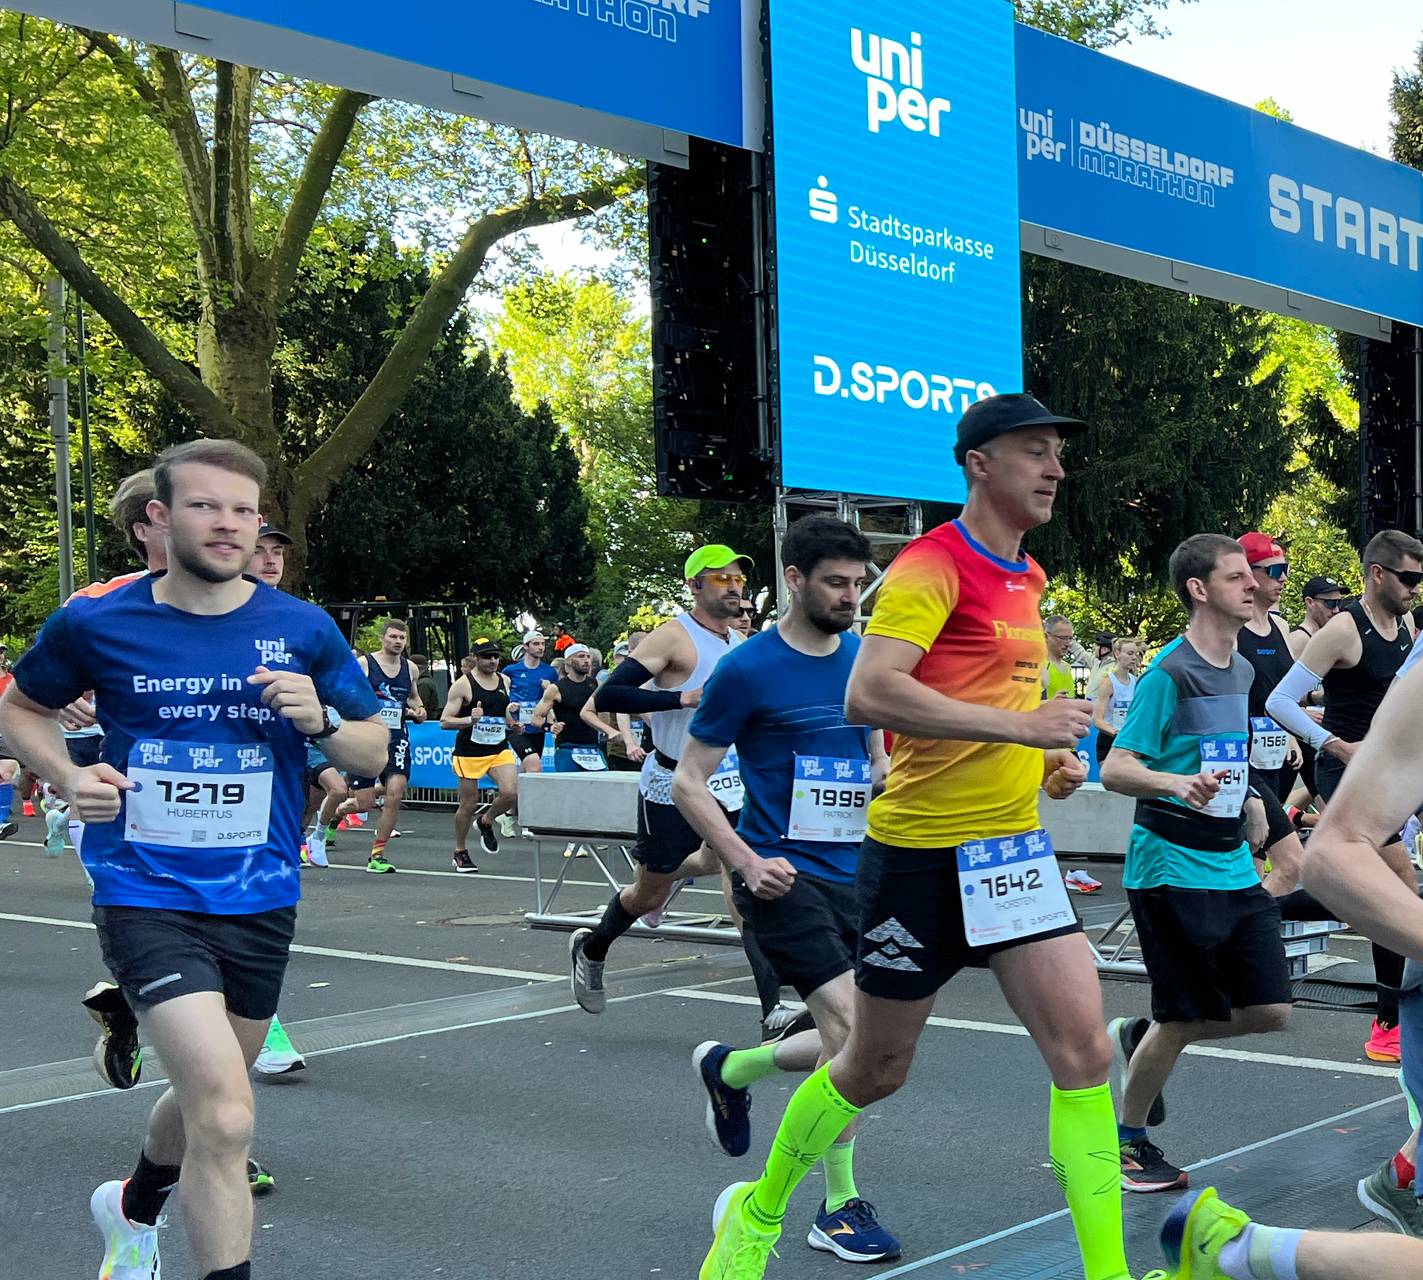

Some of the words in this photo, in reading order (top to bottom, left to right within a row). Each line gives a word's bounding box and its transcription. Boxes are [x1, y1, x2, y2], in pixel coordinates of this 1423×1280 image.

[850, 28, 922, 88] uni
[866, 74, 951, 138] per
[1019, 108, 1053, 138] uni
[1026, 132, 1066, 163] per
[1079, 121, 1234, 188] DÜSSELDORF
[1078, 146, 1215, 208] MARATHON
[848, 205, 995, 261] Stadtsparkasse
[849, 239, 957, 284] Düsseldorf
[254, 637, 285, 652] uni
[261, 649, 293, 665] per
[132, 675, 215, 695] Energy
[221, 673, 242, 691] in
[158, 703, 222, 722] every
[227, 702, 276, 724] step.
[140, 741, 164, 754] uni
[188, 745, 215, 759] uni
[237, 745, 260, 759] uni
[143, 752, 173, 766] per
[193, 757, 223, 770] per
[240, 756, 267, 771] per
[156, 779, 245, 805] 1219
[810, 788, 866, 808] 1995
[167, 807, 233, 819] HUBERTUS
[217, 830, 262, 840] D.SPORTS
[980, 868, 1043, 898] 1642
